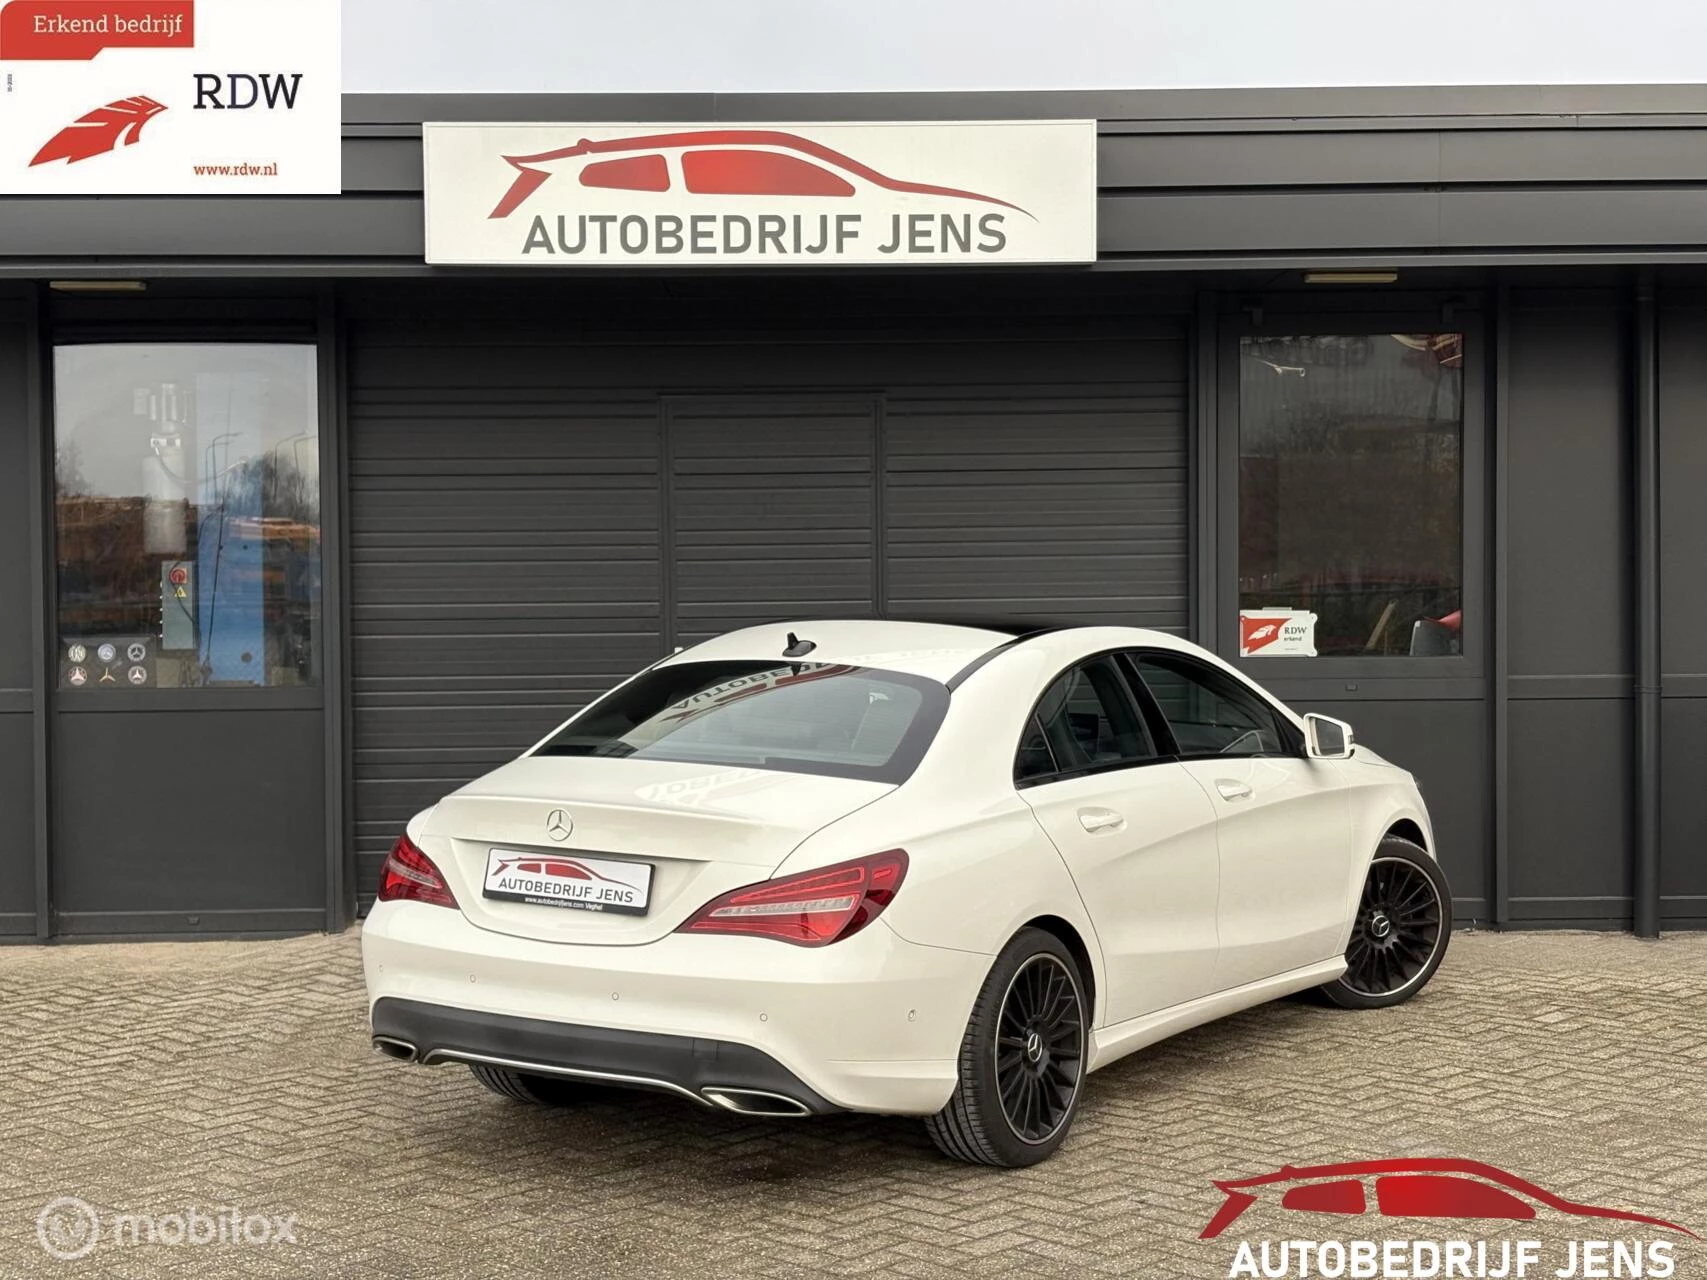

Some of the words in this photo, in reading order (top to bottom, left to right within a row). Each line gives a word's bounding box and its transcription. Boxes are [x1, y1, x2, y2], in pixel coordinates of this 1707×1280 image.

[521, 214, 862, 255] AUTOBEDRIJF
[877, 213, 1007, 254] JENS
[1284, 626, 1307, 635] RDW
[498, 877, 593, 898] AUTOBEDRIJF
[596, 888, 634, 904] JENS
